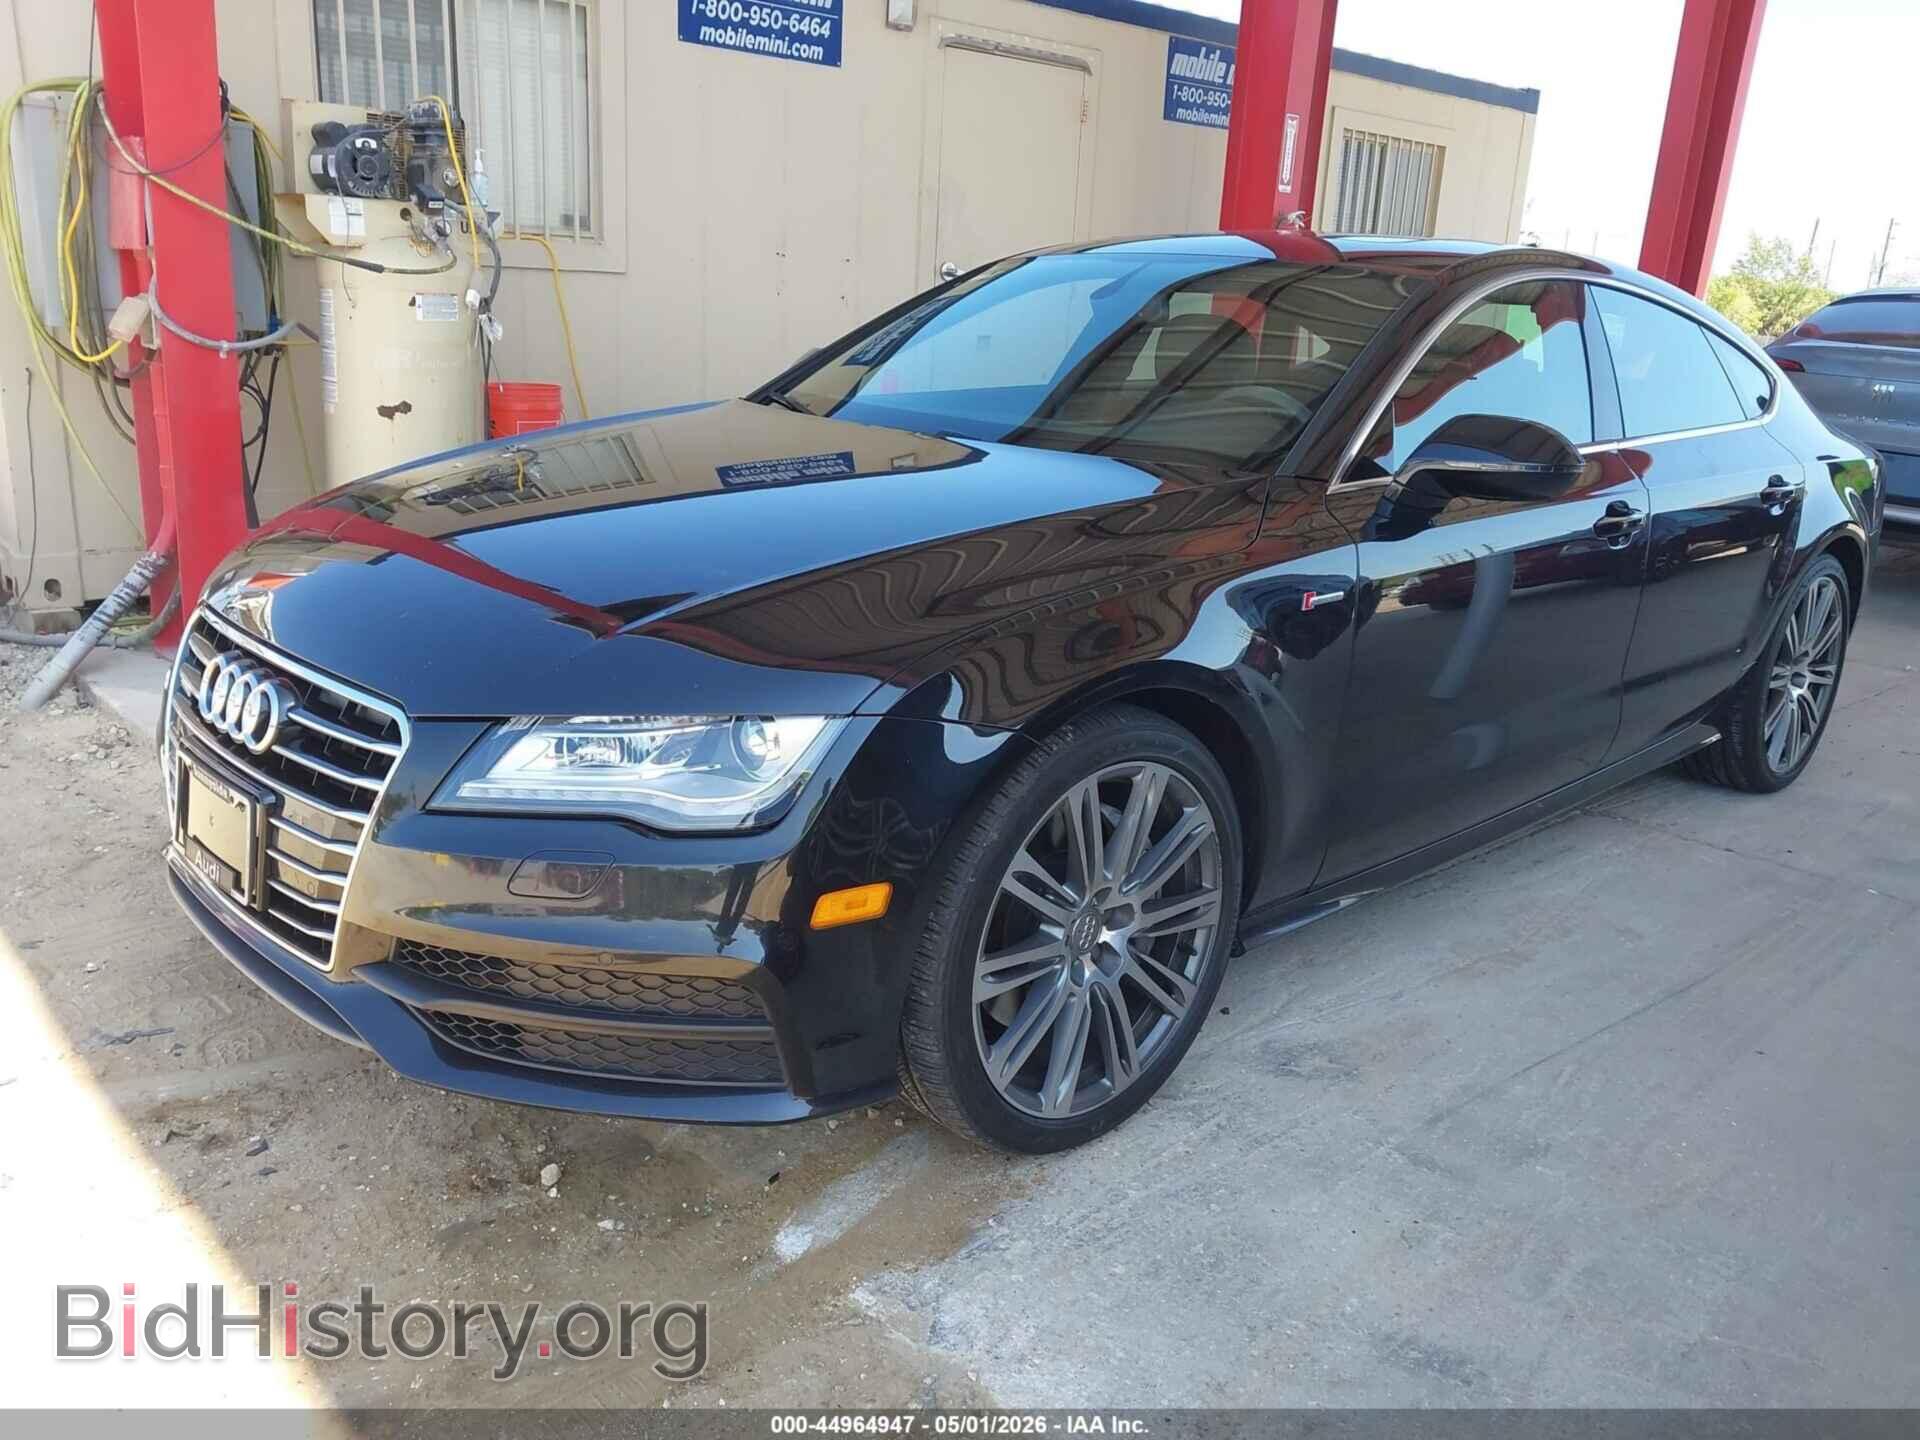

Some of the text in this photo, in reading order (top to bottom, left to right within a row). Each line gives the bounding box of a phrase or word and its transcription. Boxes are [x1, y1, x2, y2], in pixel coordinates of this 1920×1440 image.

[691, 0, 832, 39] 1-800-950-6464
[700, 24, 824, 61] mobilemini.com
[1170, 46, 1227, 83] mobile
[1173, 84, 1231, 108] 1-800-950-
[1176, 107, 1230, 127] mobilemini
[195, 850, 221, 882] Audi
